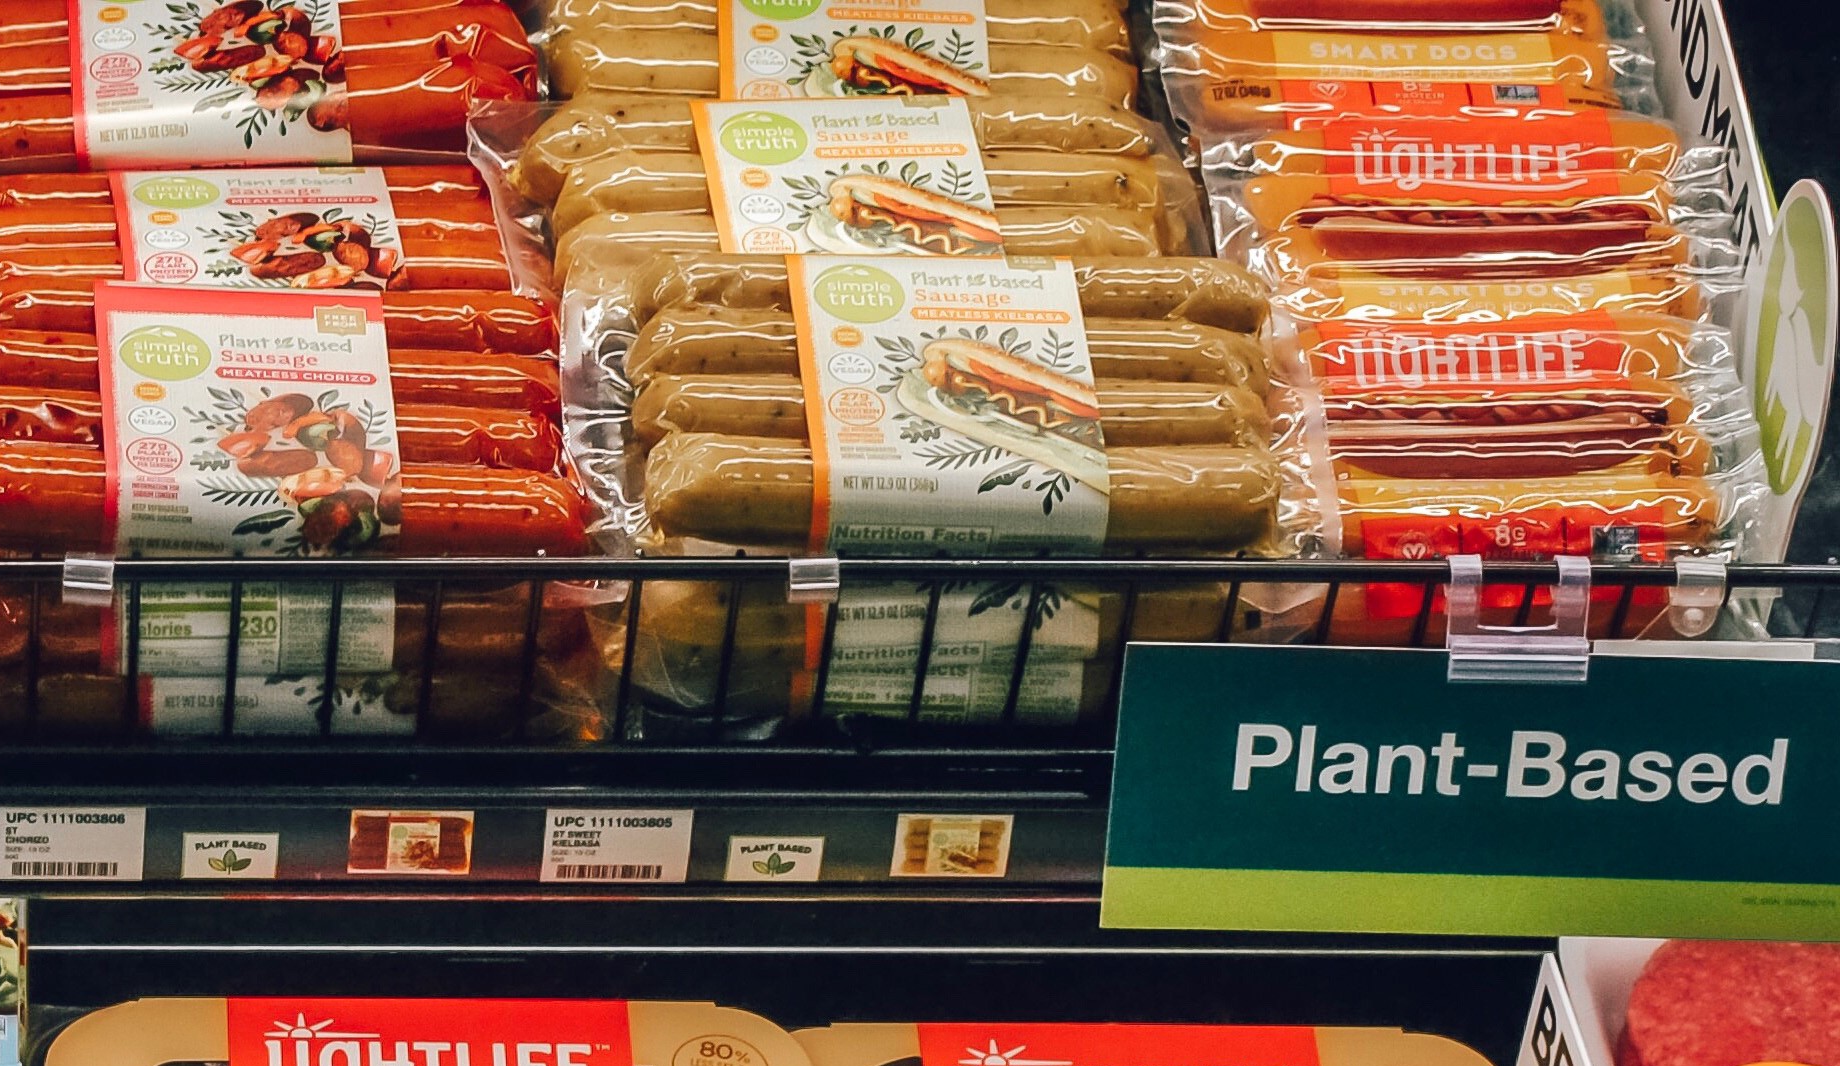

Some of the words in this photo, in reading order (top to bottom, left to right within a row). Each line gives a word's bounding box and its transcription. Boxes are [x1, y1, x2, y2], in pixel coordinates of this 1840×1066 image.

[1309, 43, 1428, 60] SMART
[1434, 43, 1518, 60] DOGS
[733, 124, 794, 139] simple
[817, 129, 910, 144] Sausage
[734, 134, 798, 151] truth
[827, 280, 892, 295] simple
[910, 271, 964, 288] Plant
[990, 274, 1044, 290] Based
[829, 291, 894, 307] truth
[915, 289, 1011, 306] Sausage
[918, 308, 992, 320] MEATLESS
[992, 310, 1065, 322] KIELBASA
[133, 341, 199, 357] simple
[218, 334, 271, 352] Plant
[298, 338, 353, 354] Based
[134, 353, 200, 367] truth
[221, 350, 319, 366] Sausage
[222, 369, 298, 379] MEATLESS
[303, 372, 371, 384] CHORIZO
[843, 475, 859, 489] NET
[860, 476, 874, 489] WT
[876, 476, 894, 489] 12.9
[895, 476, 907, 489] OZ
[834, 526, 925, 543] Nutrition
[931, 527, 988, 543] Facts
[1232, 722, 1789, 805] Plant-Based
[5, 813, 37, 824] UPC
[554, 816, 585, 827] UPC
